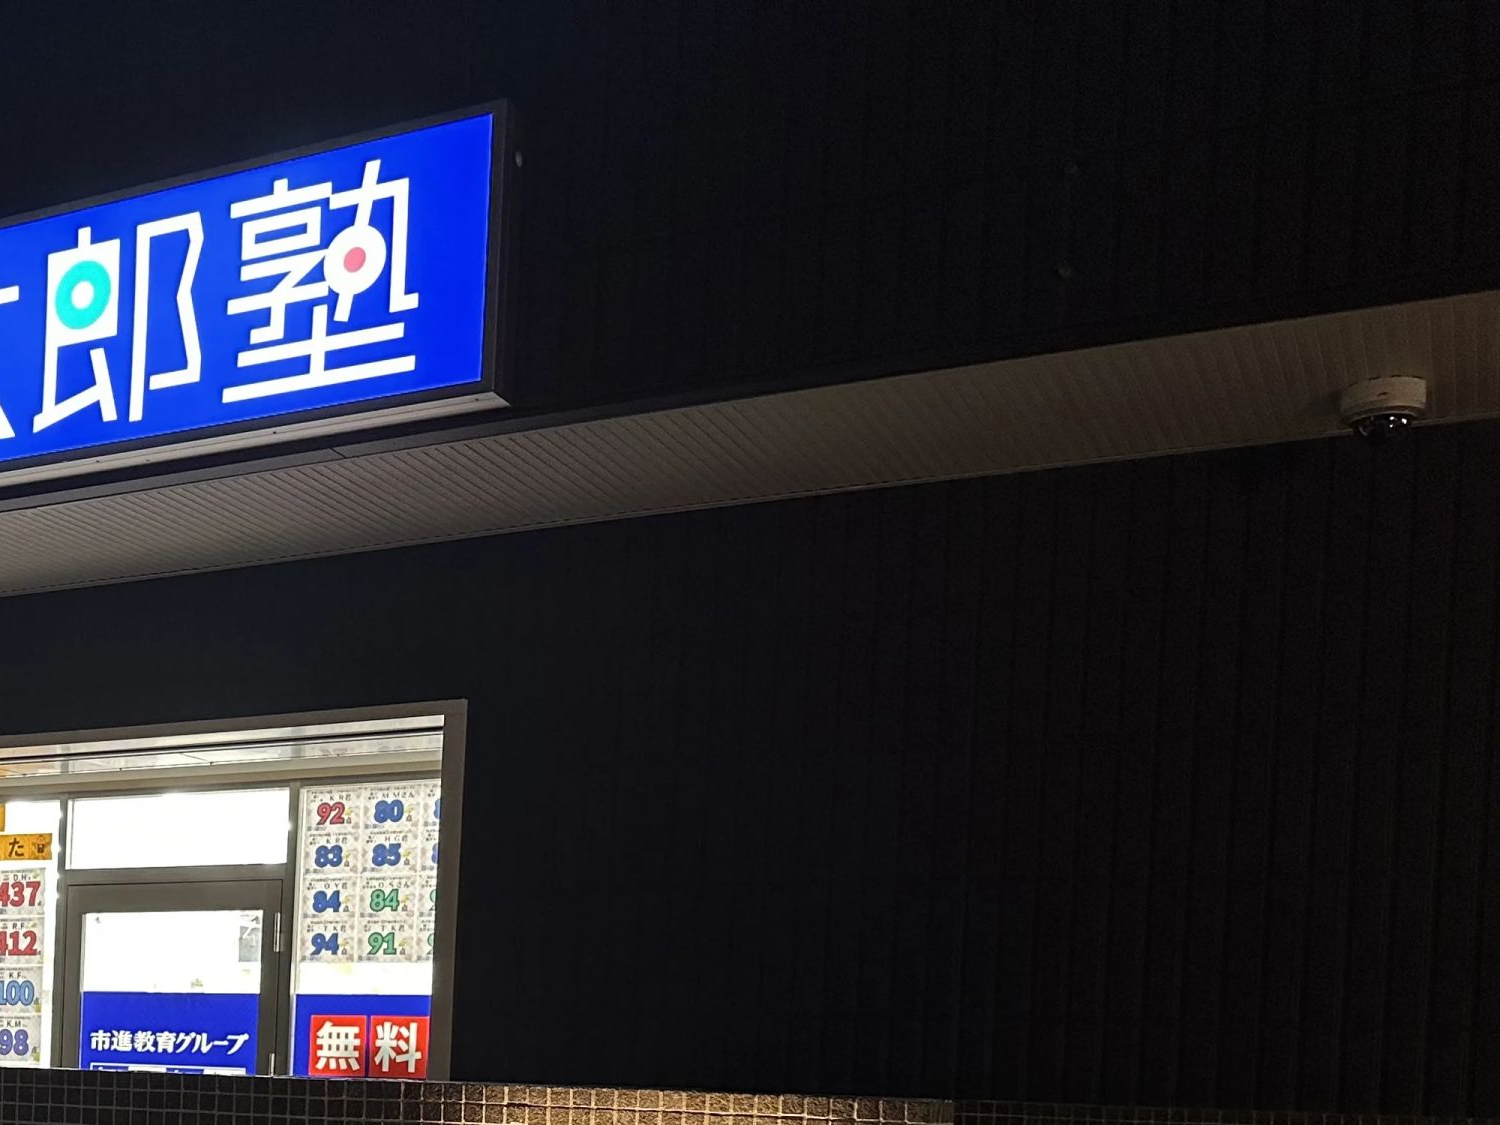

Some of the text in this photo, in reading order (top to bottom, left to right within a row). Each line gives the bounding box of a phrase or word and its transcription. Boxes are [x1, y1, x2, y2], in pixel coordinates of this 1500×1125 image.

[316, 802, 345, 826] 92
[374, 799, 404, 823] 80
[372, 843, 401, 866] 85
[312, 890, 341, 913] 84
[370, 888, 400, 912] 84
[310, 932, 340, 956] 94
[367, 932, 397, 955] 91
[90, 1029, 249, 1055] 市進教育グループ
[315, 1020, 422, 1073] 無料
